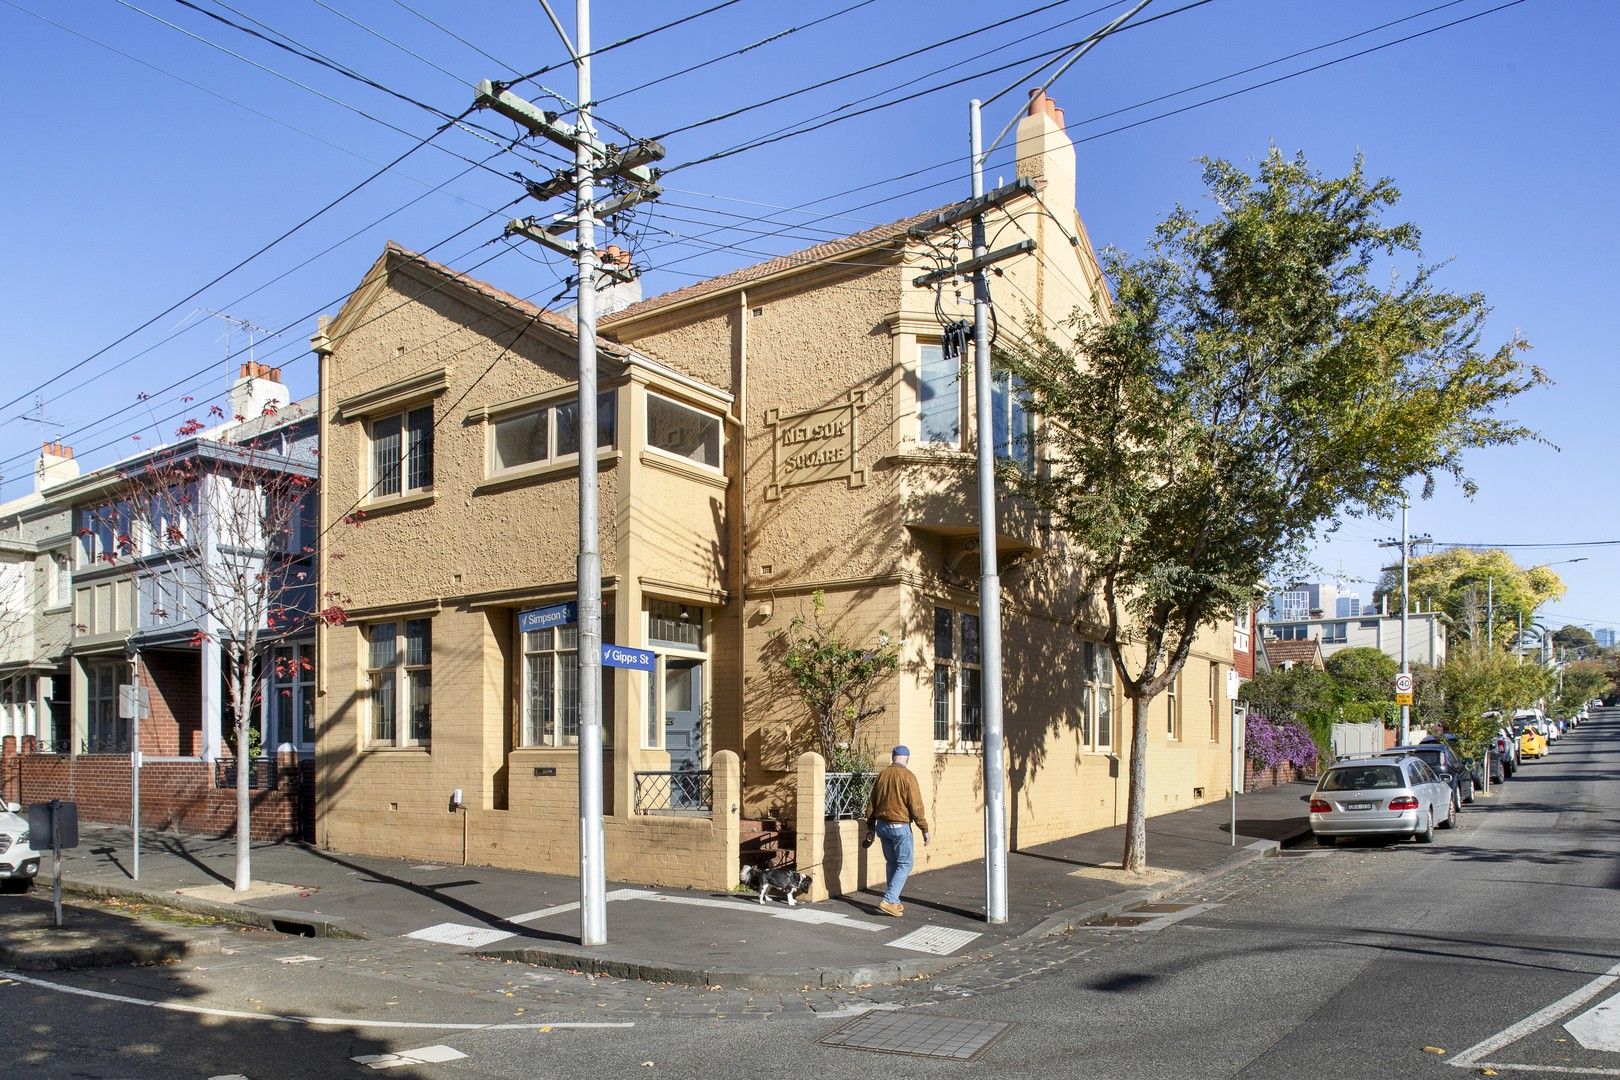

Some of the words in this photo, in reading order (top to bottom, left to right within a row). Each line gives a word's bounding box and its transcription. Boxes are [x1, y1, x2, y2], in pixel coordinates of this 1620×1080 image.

[528, 611, 561, 625] Simpson
[562, 607, 571, 619] St
[612, 650, 637, 664] Gipps
[639, 653, 649, 664] St
